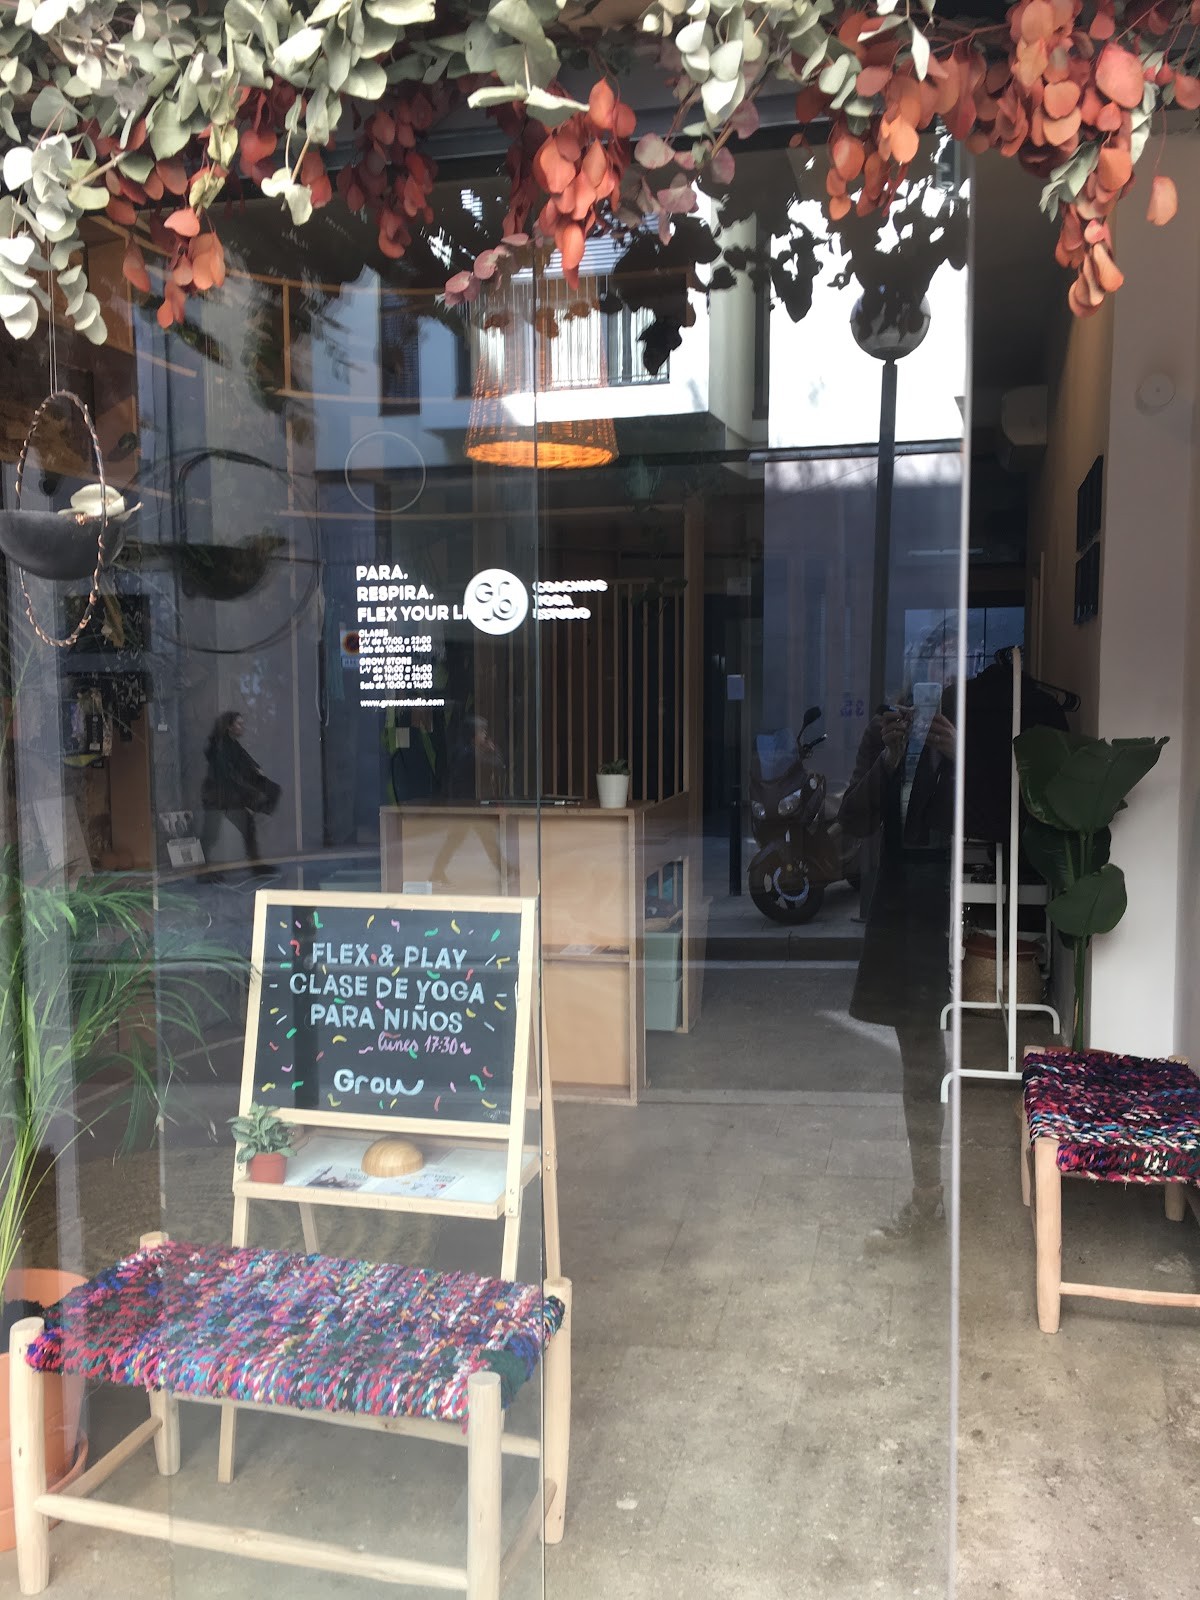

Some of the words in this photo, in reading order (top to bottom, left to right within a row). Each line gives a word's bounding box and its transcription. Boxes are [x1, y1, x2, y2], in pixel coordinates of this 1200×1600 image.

[356, 564, 409, 581] PARA.
[356, 585, 434, 602] RESPIRA.
[533, 595, 573, 606] YOGA
[357, 606, 398, 622] FLEX
[400, 605, 449, 621] YOUR
[358, 629, 388, 637] CLASES
[372, 637, 381, 645] de
[383, 637, 403, 645] 07:00
[375, 645, 384, 653] de
[386, 645, 405, 653] 10:00
[360, 657, 385, 665] GROW
[386, 657, 411, 665] STORE
[373, 665, 382, 673] de
[373, 673, 383, 681] de
[376, 681, 385, 689] de
[386, 681, 405, 689] 10:00
[312, 942, 370, 966] FLEX
[379, 945, 395, 967] &
[404, 945, 467, 969] PLAY
[289, 972, 368, 998] CLASE
[376, 976, 409, 999] DE
[417, 979, 484, 1005] YOGA
[310, 1004, 376, 1030] PARA
[384, 1004, 463, 1034] NIÑOS
[378, 1033, 419, 1053] lunes
[424, 1035, 458, 1054] 17:30
[333, 1068, 425, 1095] Grow
